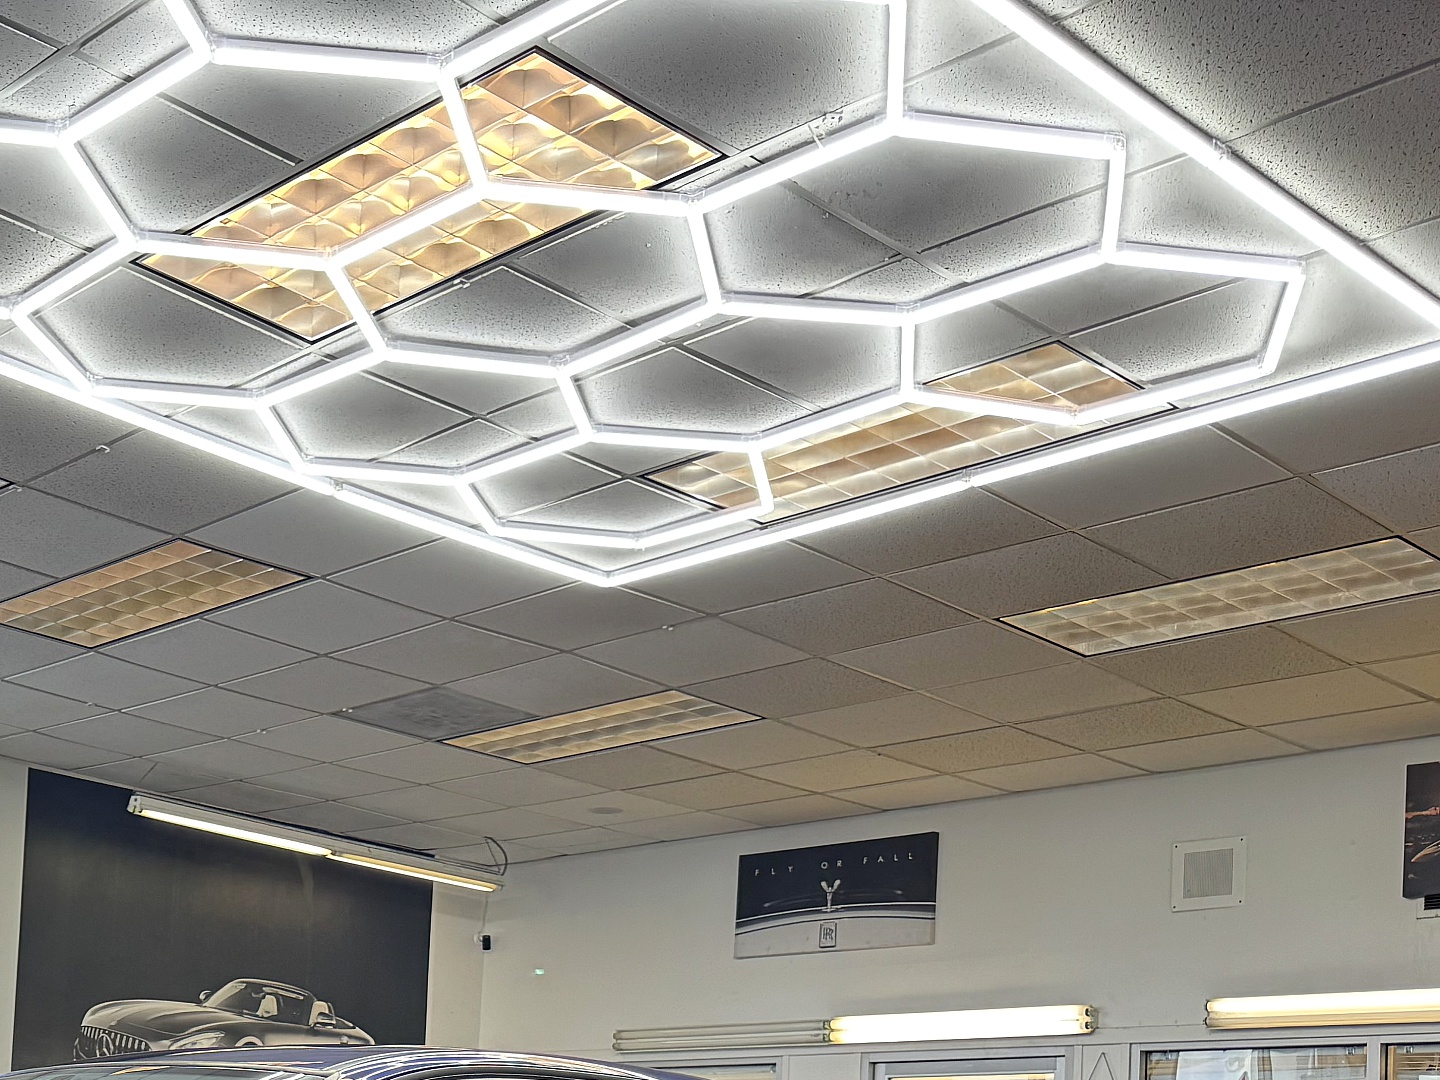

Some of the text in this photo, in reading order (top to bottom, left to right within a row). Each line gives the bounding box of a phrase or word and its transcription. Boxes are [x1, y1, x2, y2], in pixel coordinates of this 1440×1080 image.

[754, 852, 914, 877] FLY OR FALL
